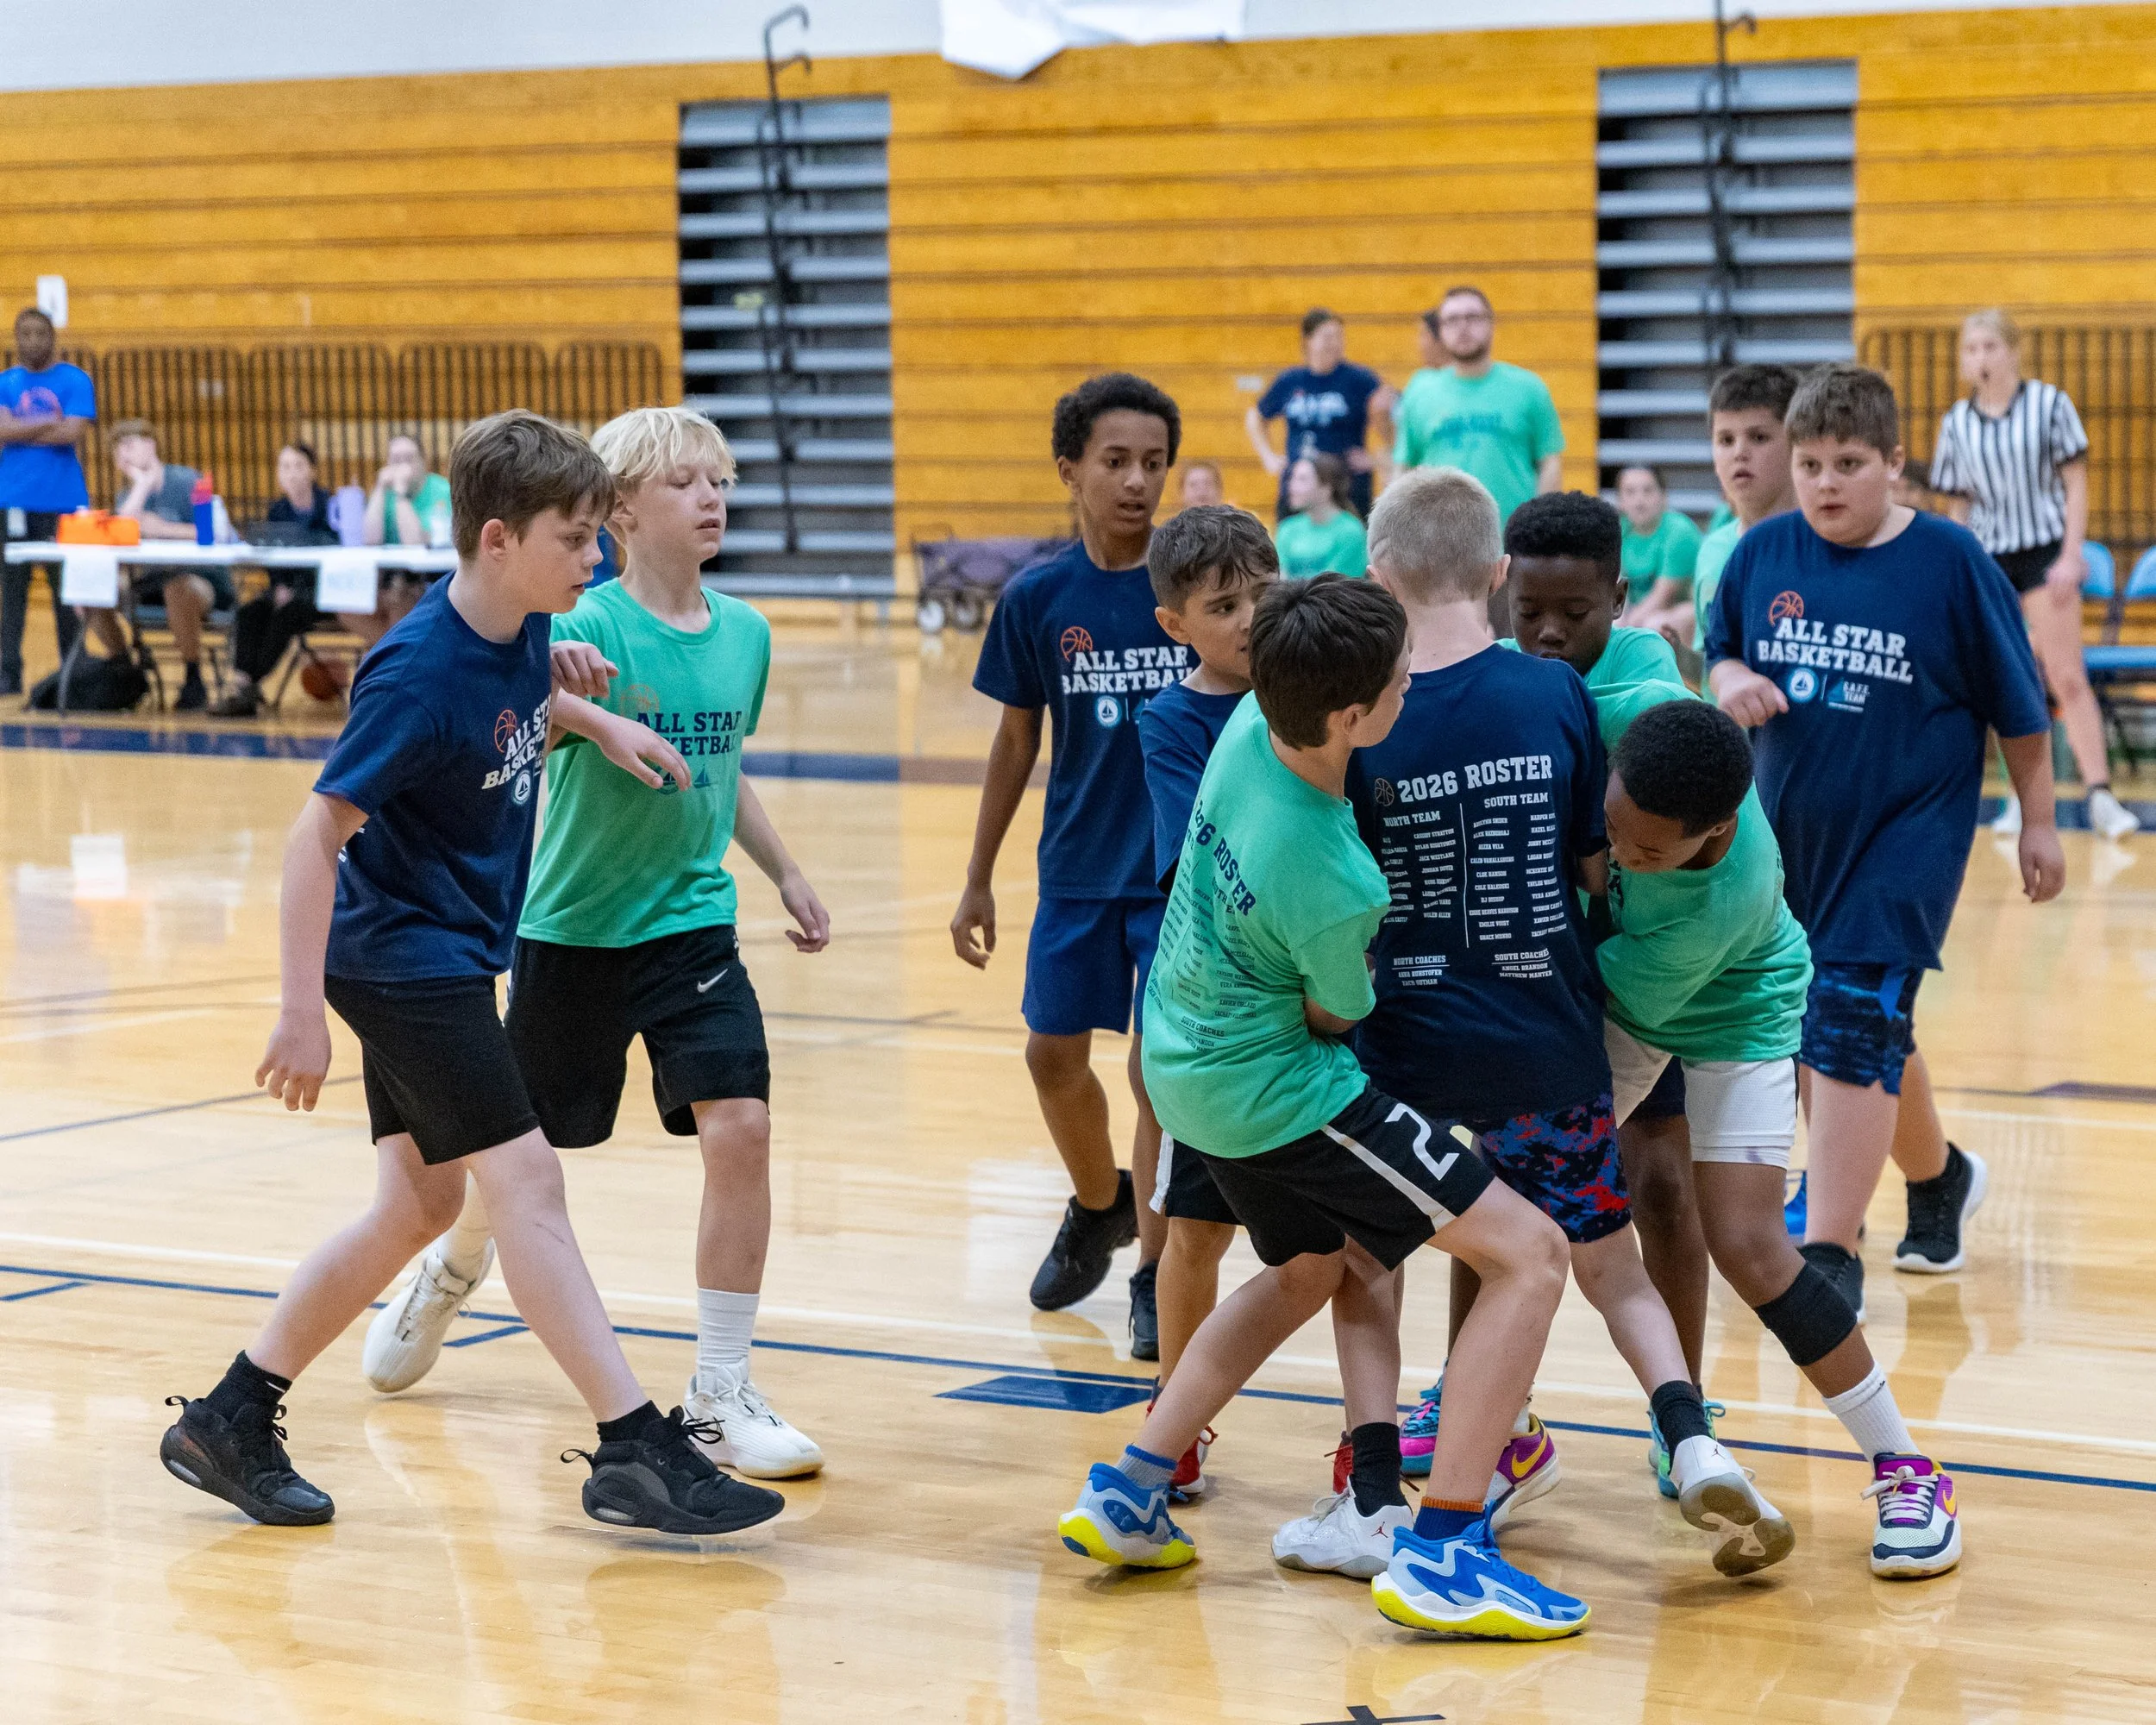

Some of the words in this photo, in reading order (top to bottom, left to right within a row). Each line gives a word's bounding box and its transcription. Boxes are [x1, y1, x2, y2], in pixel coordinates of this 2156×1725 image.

[1775, 617, 1827, 644] ALL
[1832, 624, 1906, 659] STAR
[1073, 650, 1120, 673] ALL
[1124, 646, 1188, 670] STAR
[1758, 639, 1914, 685] BASKETBALL
[505, 719, 530, 762] ALL
[1397, 771, 1458, 803] 2026
[1464, 755, 1552, 789] ROSTER
[1484, 794, 1518, 808] SOUTH
[1520, 792, 1548, 805] TEAM
[1383, 815, 1411, 827] NORTH
[1412, 811, 1441, 824] TEAM
[1394, 957, 1413, 966] NORTH
[1414, 955, 1446, 965] COACHES
[1495, 952, 1519, 961] SOUTH
[1195, 1022, 1225, 1037] COACHES
[1384, 1102, 1460, 1181] 2
